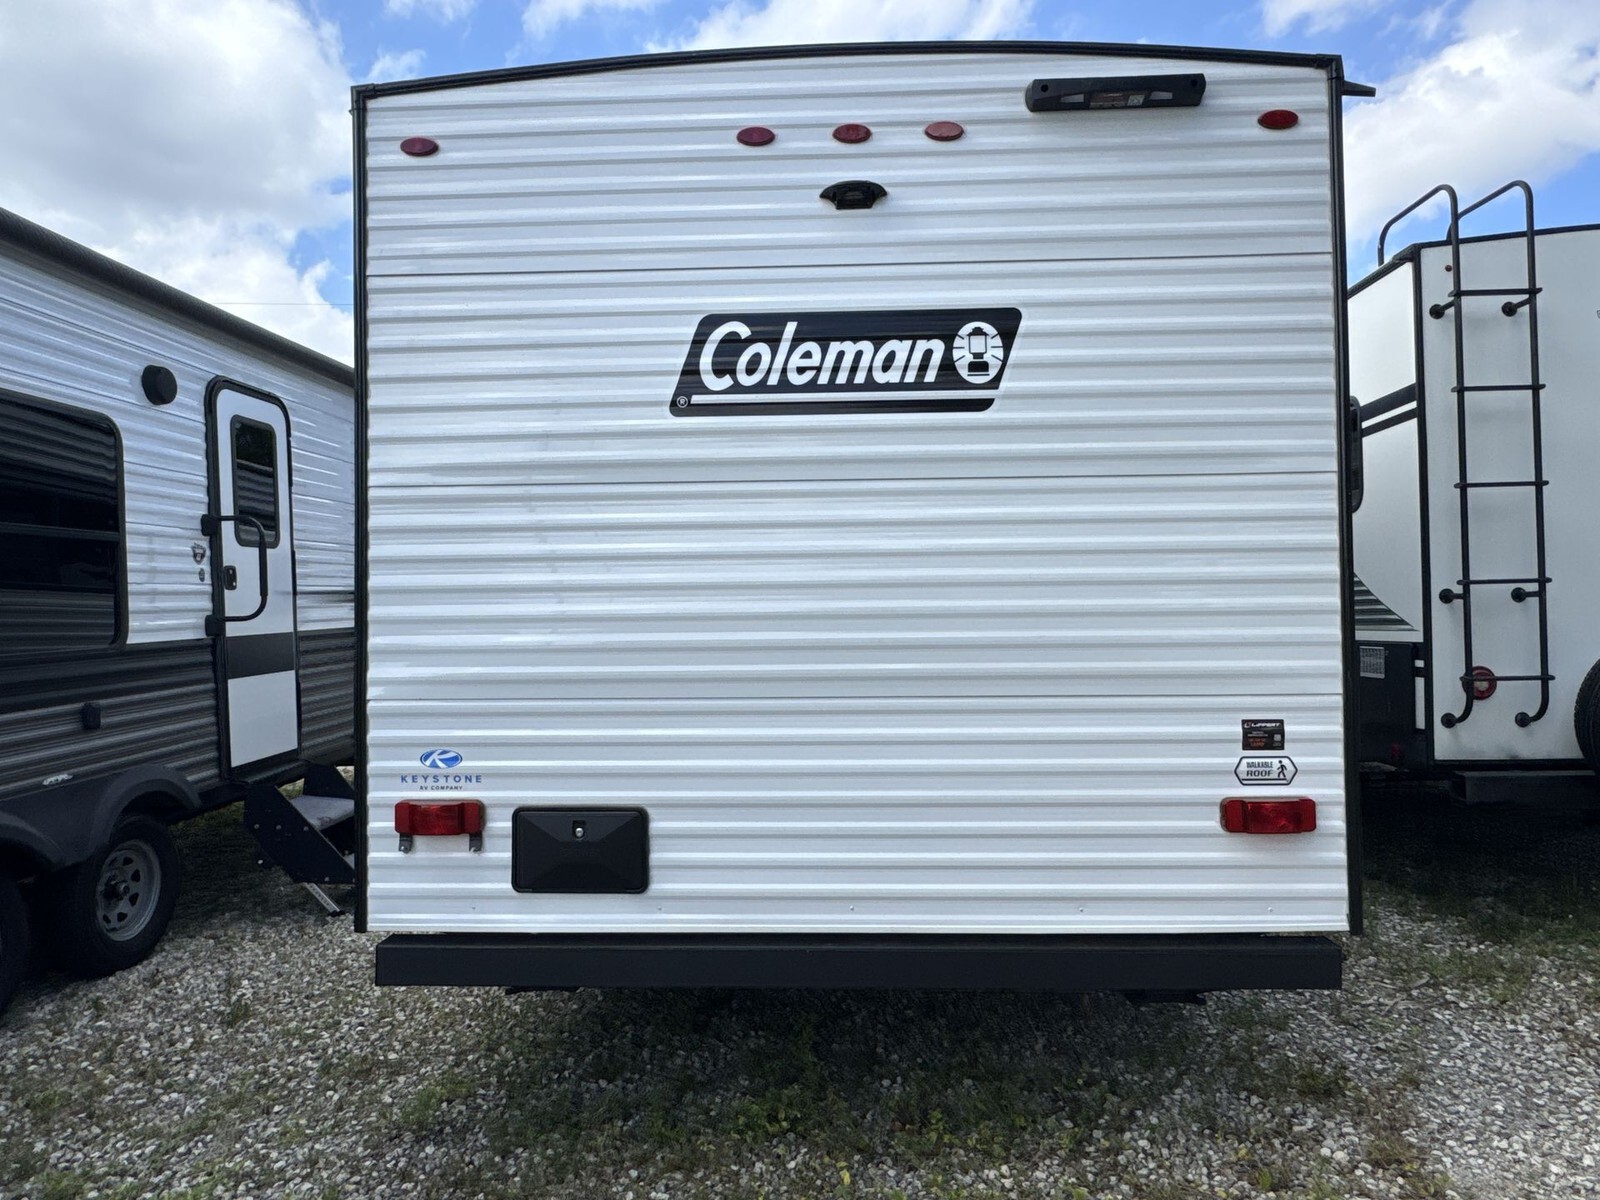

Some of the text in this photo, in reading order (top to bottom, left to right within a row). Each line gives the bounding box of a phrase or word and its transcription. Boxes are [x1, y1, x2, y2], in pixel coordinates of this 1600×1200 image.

[700, 321, 946, 391] Coleman
[1246, 761, 1274, 769] WALKABLE
[400, 774, 482, 784] KEYSTONE
